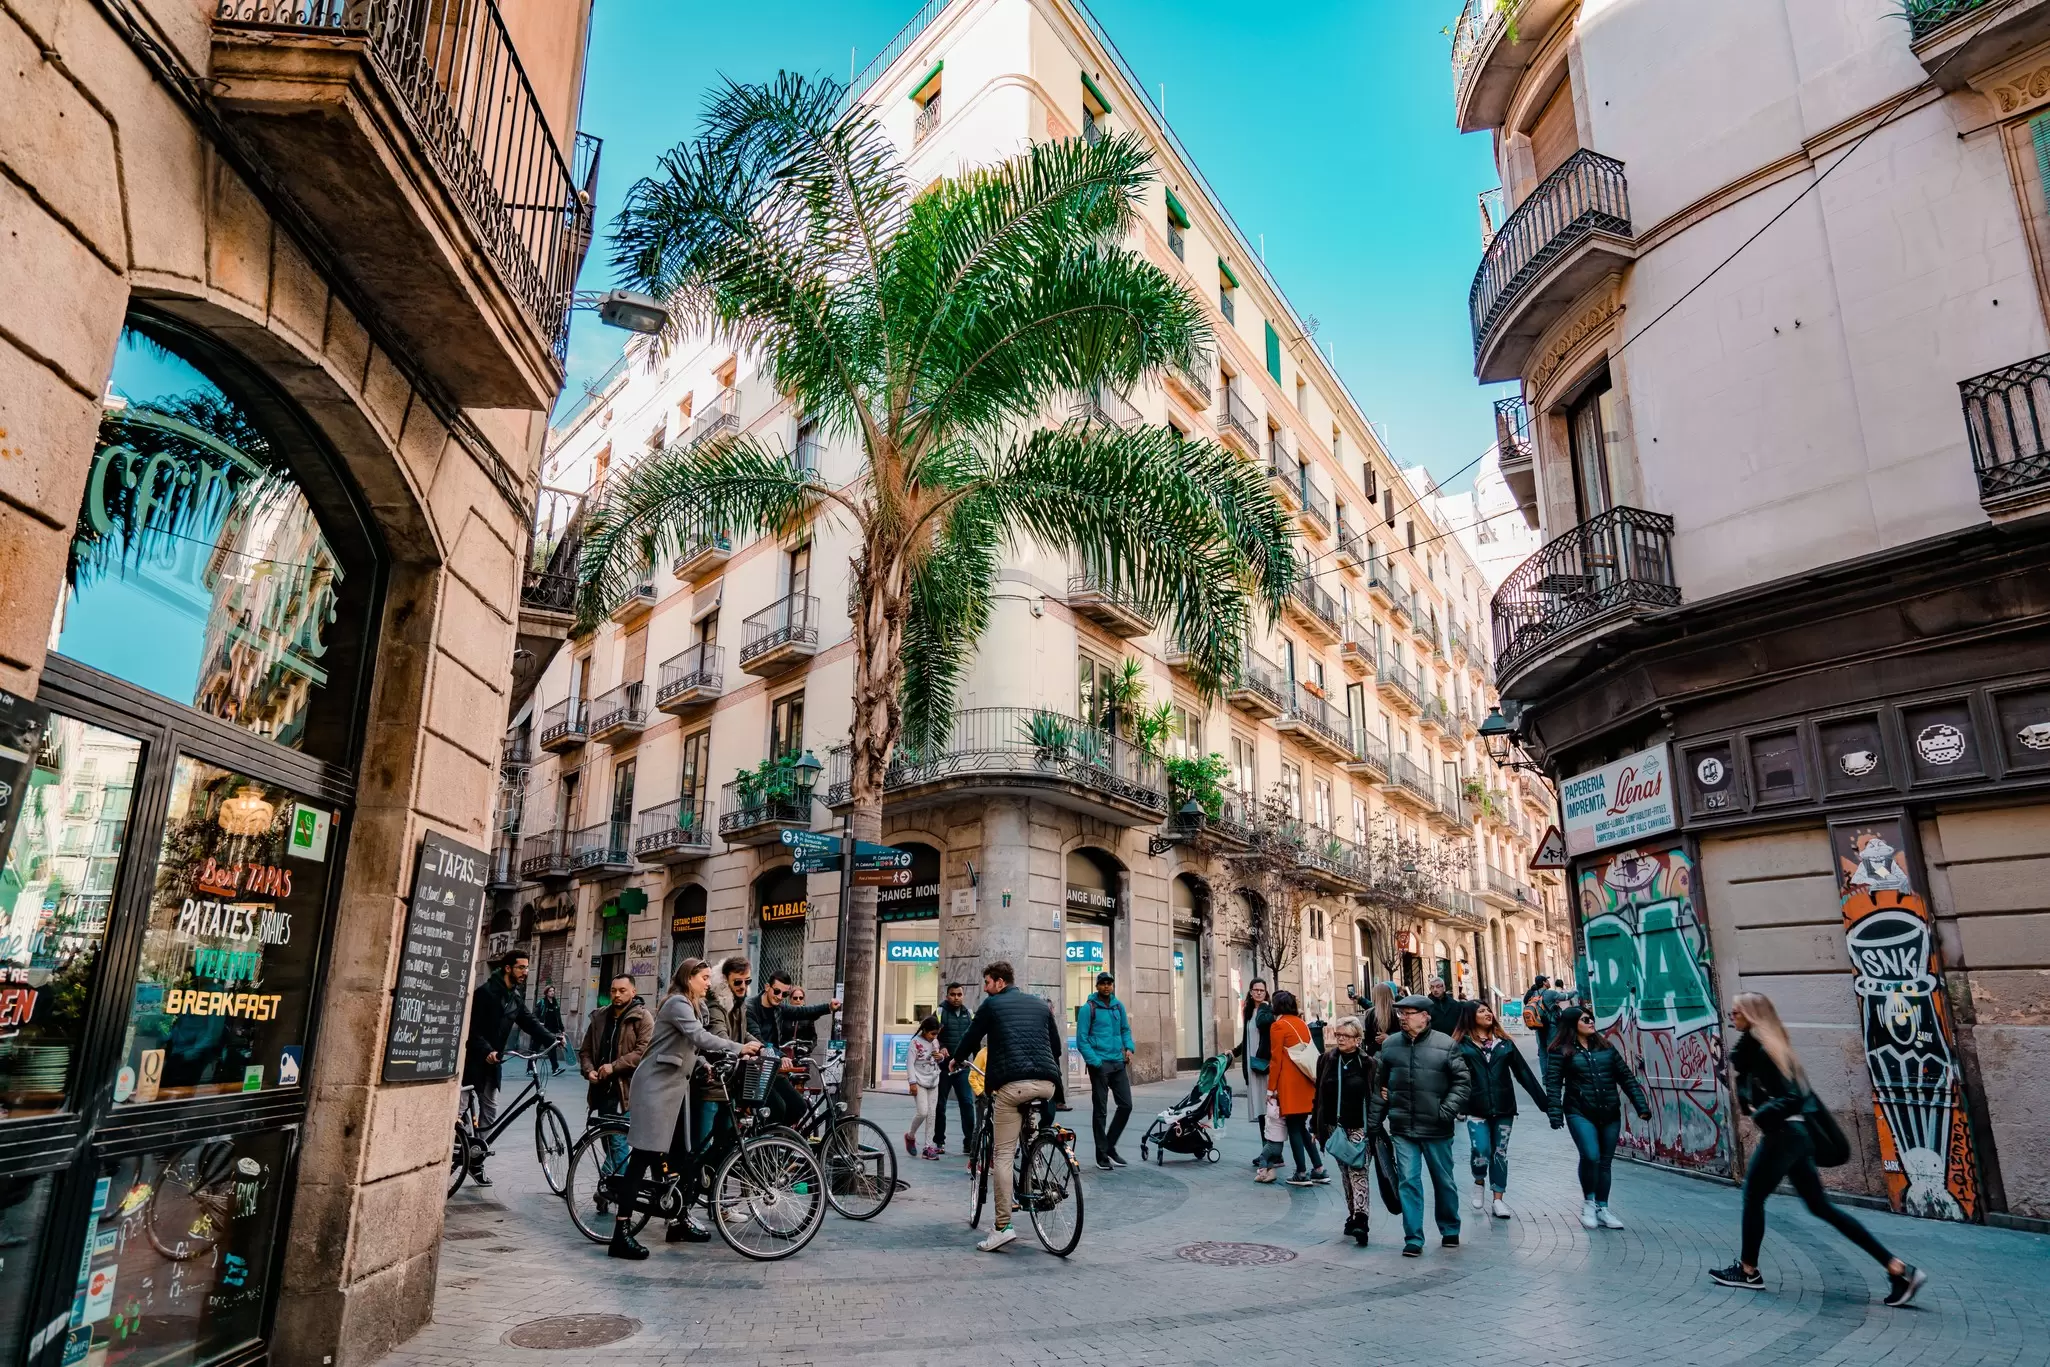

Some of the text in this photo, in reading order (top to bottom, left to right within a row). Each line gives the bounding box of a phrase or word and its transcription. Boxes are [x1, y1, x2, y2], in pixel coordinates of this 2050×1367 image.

[1564, 773, 1605, 801] PAPERERIA
[1606, 766, 1662, 816] Llenas
[1708, 792, 1726, 808] 32
[1566, 793, 1607, 819] IMPREMTA
[201, 856, 292, 897] Best TAPAS
[437, 847, 475, 884] TAPAS
[877, 887, 912, 902] CHANGE
[1090, 893, 1116, 909] MONEY
[177, 898, 292, 945] PATATES BRAVES
[195, 948, 261, 981] VERMUT
[1091, 946, 1104, 958] CH
[1861, 946, 1918, 978] SNK
[165, 989, 282, 1021] BREAKFAST
[400, 997, 423, 1023] GREEN
[1916, 1030, 1934, 1043] SARK
[1883, 1159, 1901, 1172] SARK
[98, 1233, 115, 1248] VISA
